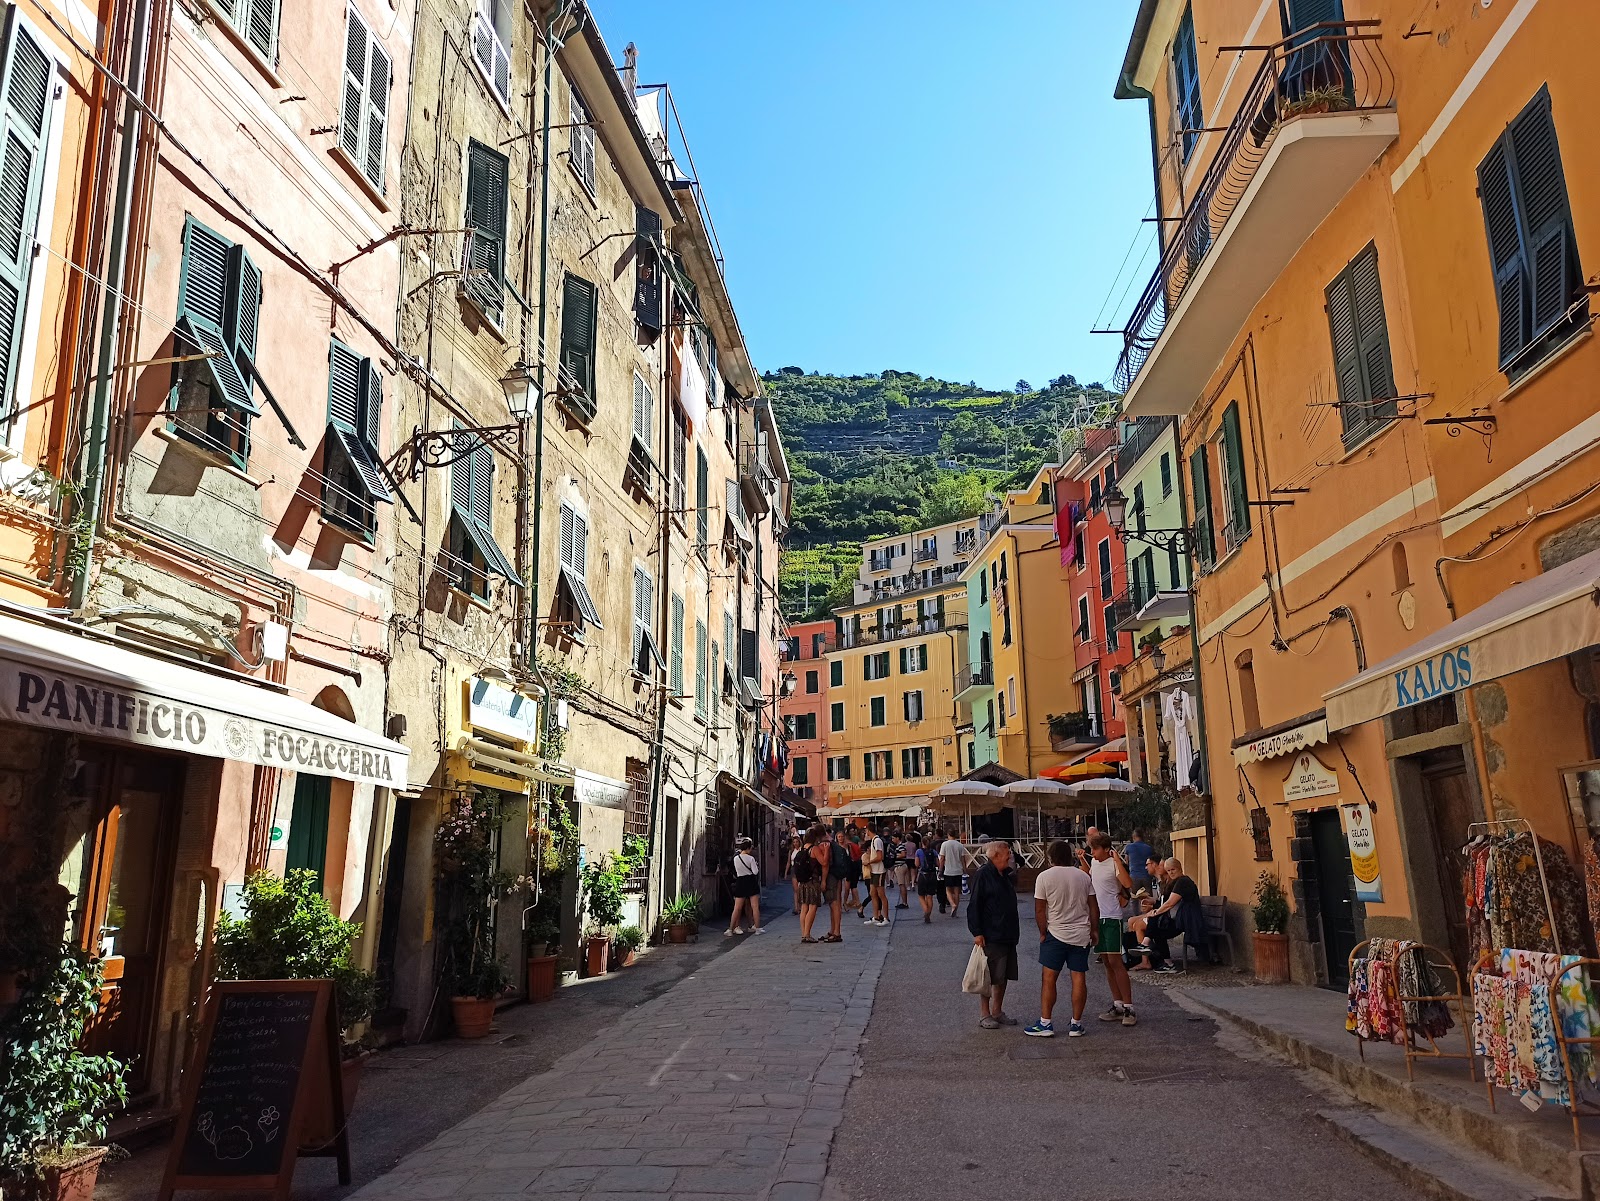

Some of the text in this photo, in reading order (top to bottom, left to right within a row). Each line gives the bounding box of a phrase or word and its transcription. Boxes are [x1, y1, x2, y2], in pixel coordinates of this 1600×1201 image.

[1395, 645, 1471, 707] KALOS
[16, 672, 206, 745] PANIFICIO
[263, 728, 393, 782] FOCACCERIA
[1257, 736, 1281, 757] GELATO
[1300, 773, 1316, 784] GELATO
[1352, 828, 1369, 838] GELATO
